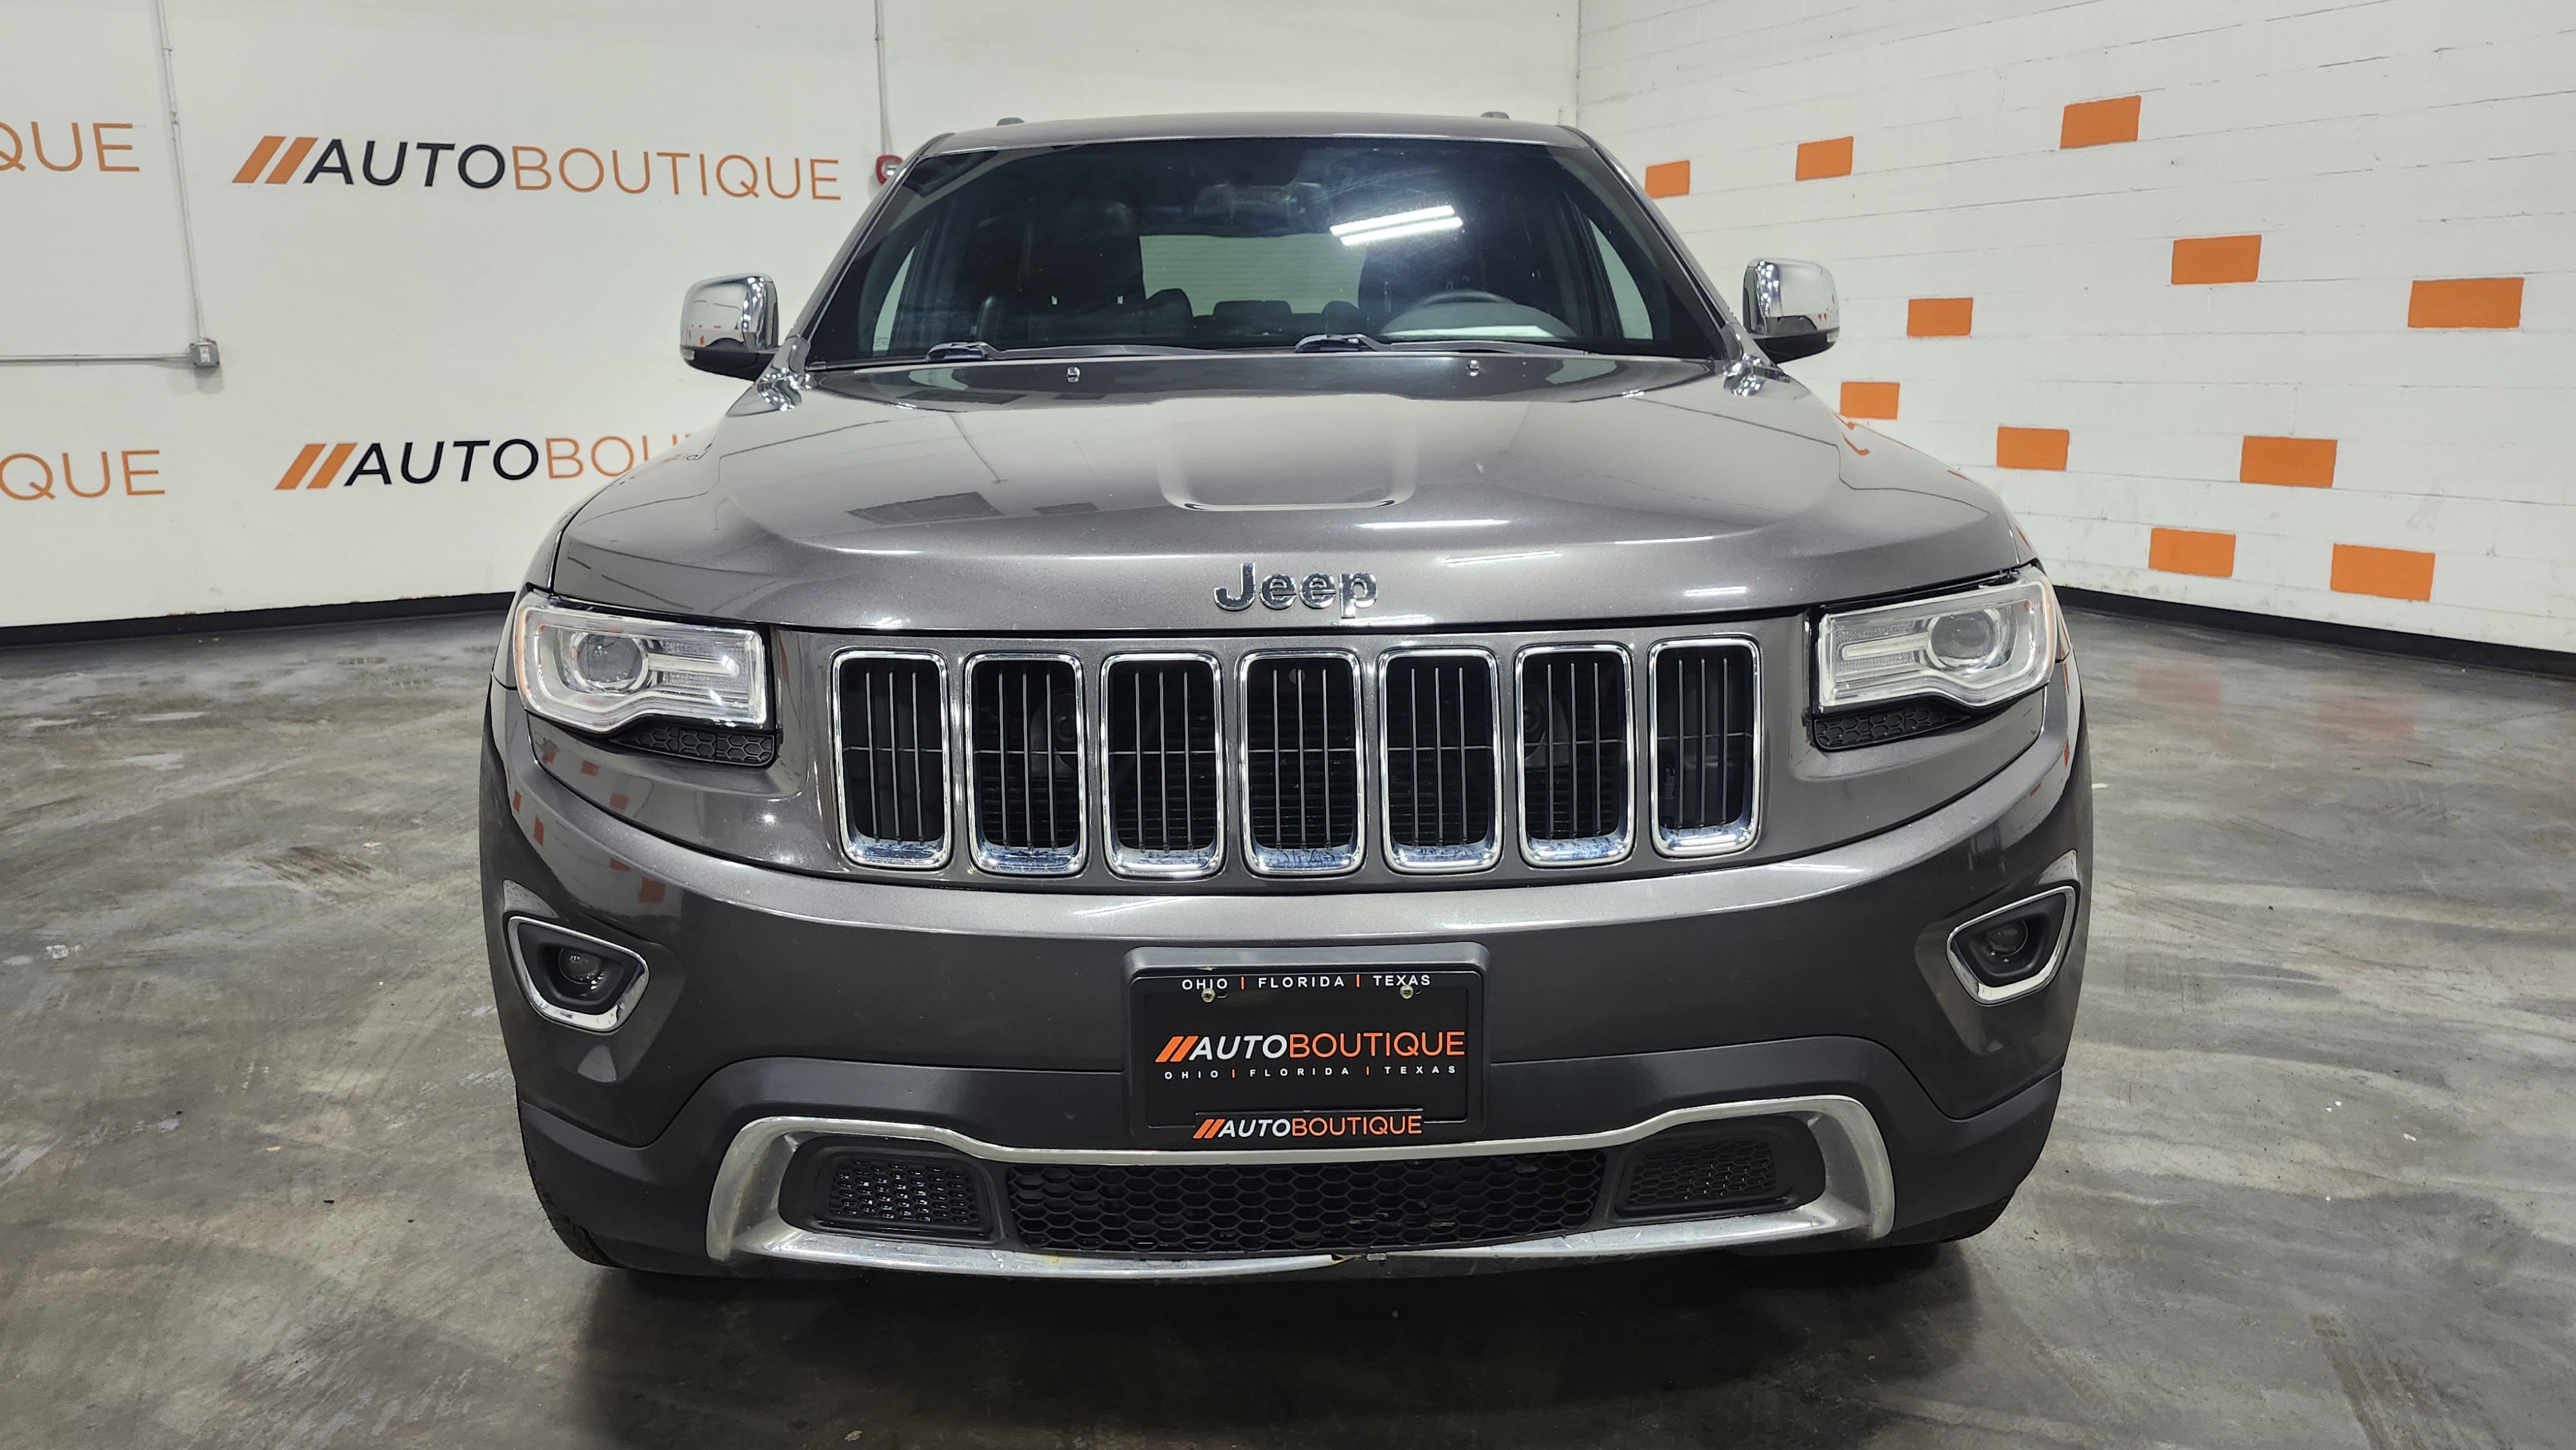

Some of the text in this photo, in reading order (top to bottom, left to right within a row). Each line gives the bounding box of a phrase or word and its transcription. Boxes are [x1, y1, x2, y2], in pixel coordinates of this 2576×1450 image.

[303, 138, 841, 200] AUTOBOUTIQUE
[0, 449, 166, 501] QUE
[343, 434, 692, 487] AUTOBO
[1214, 562, 1379, 619] Jeep
[1182, 974, 1431, 991] OHIO FLORIDA TEXAS
[1188, 1031, 1466, 1060] AUTOBOUTIQUE
[1164, 1064, 1457, 1080] OHIO FLORIDA TEXAS
[1217, 1115, 1423, 1138] AUTOBOUTIQUE
